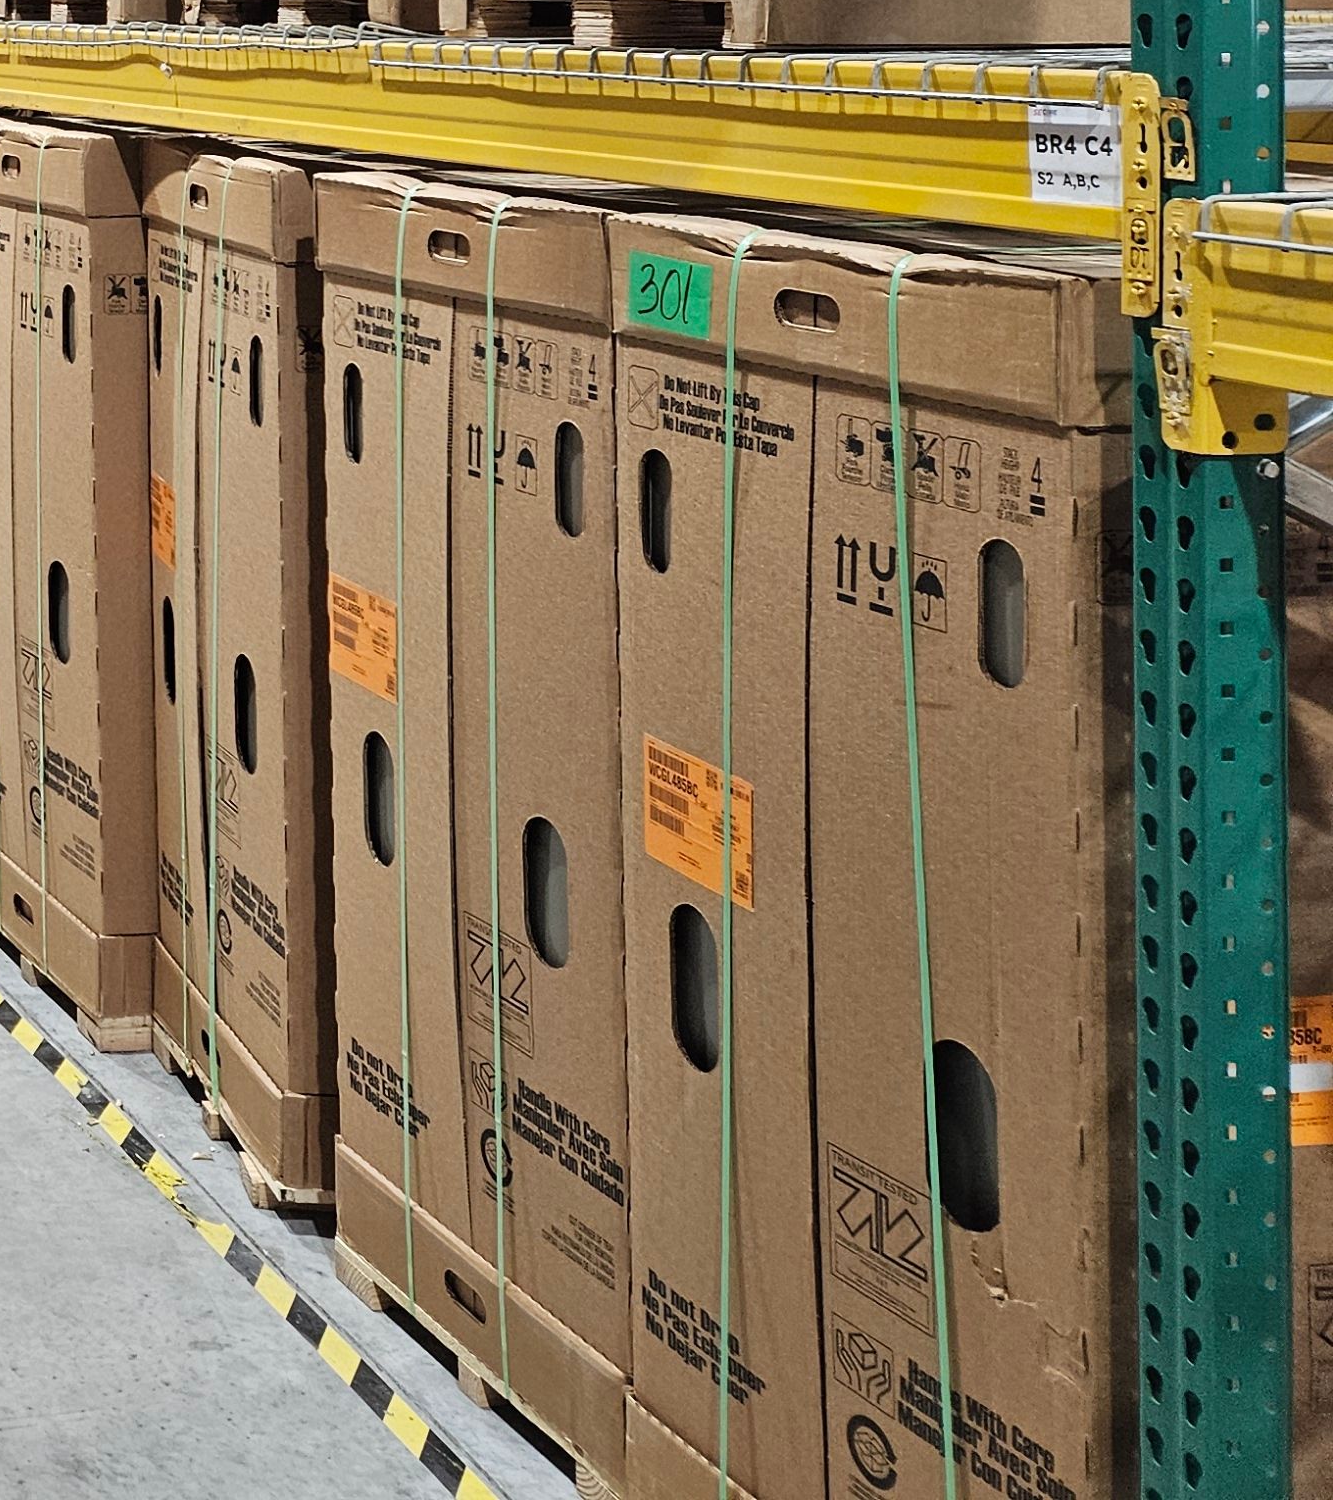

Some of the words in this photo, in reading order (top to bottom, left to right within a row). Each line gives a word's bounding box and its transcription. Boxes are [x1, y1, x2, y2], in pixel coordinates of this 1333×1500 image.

[1035, 133, 1077, 156] BR4
[1084, 135, 1113, 157] C4
[1037, 171, 1055, 186] S2
[1062, 174, 1100, 190] A,B,C
[637, 261, 693, 325] 301
[664, 374, 675, 392] Do
[676, 377, 691, 396] Not
[693, 380, 709, 400] Lift
[709, 384, 722, 405] By
[743, 392, 760, 412] Cap
[670, 397, 684, 413] Pas
[739, 412, 750, 430] Le
[675, 417, 714, 440] Levantar
[733, 430, 754, 451] Esta
[756, 435, 778, 457] Tapa
[648, 761, 699, 798] WCGL485BC
[351, 1036, 364, 1061] Do
[366, 1051, 385, 1077] not
[361, 1062, 380, 1092] Pas
[349, 1071, 363, 1097] No
[364, 1083, 393, 1118] Dejar
[517, 1076, 552, 1117] Handle
[554, 1101, 581, 1135] With
[583, 1120, 611, 1155] Care
[511, 1112, 556, 1159] Manejar
[558, 1146, 579, 1176] Con
[581, 1160, 624, 1207] Cuidado
[512, 1093, 566, 1144] Manipuler
[568, 1128, 597, 1167] Avec
[599, 1152, 624, 1185] Soin
[832, 1152, 878, 1181] TRANSIT
[877, 1176, 918, 1206] TESTED
[641, 1283, 660, 1316] Ne
[662, 1301, 690, 1340] Pas
[648, 1266, 667, 1299] Do
[670, 1287, 697, 1323] not
[645, 1308, 664, 1342] No
[667, 1327, 707, 1373] Dejar
[965, 1394, 1008, 1445] With
[1011, 1424, 1056, 1475] Care
[987, 1433, 1032, 1484] Avec
[970, 1449, 1003, 1493] Con
